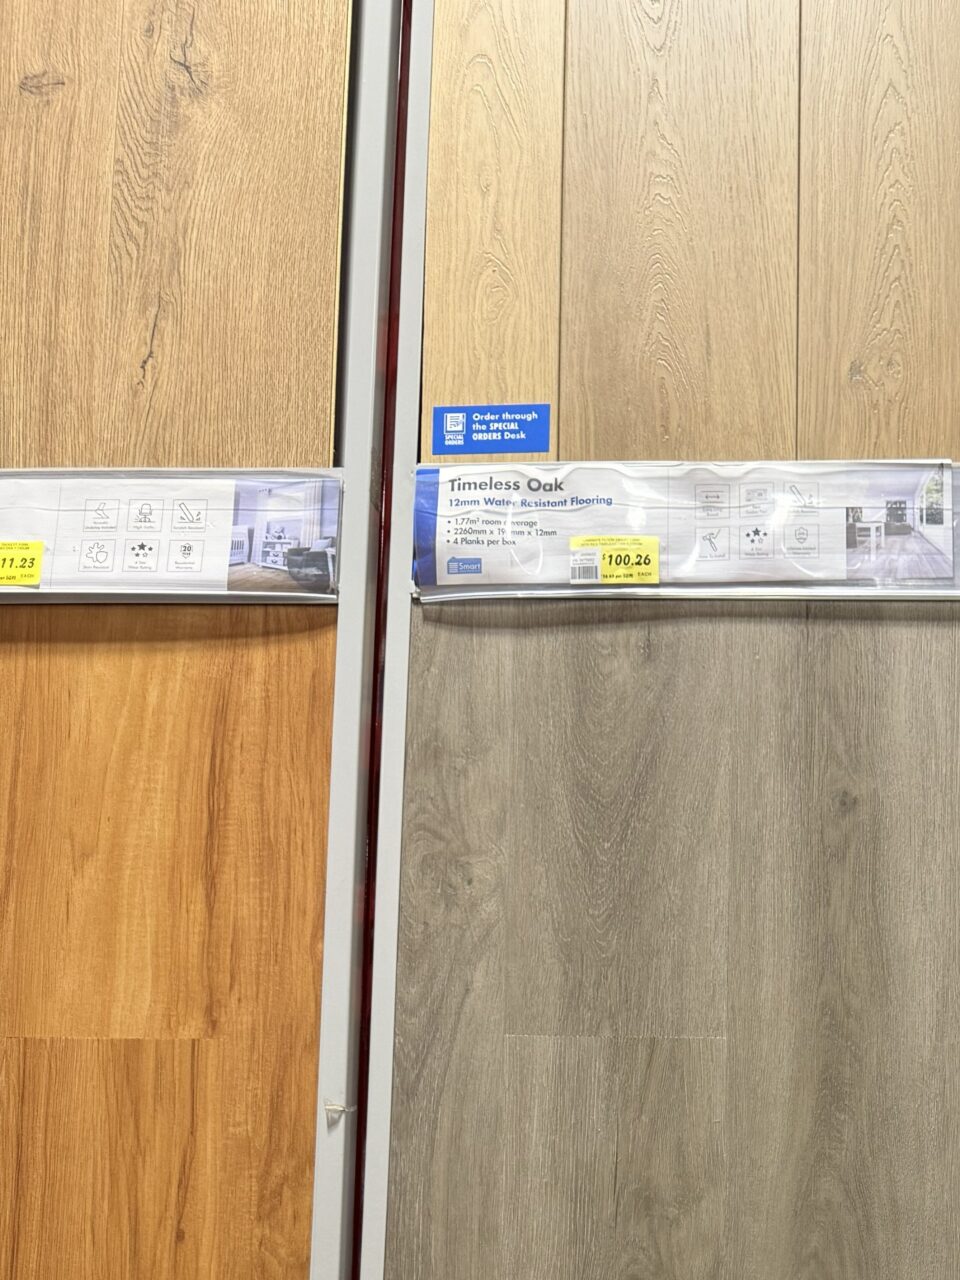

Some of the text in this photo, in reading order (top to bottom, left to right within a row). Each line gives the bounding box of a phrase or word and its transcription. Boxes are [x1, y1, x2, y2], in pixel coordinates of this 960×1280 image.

[472, 412, 538, 421] Order through
[490, 422, 518, 430] SPECIAL
[472, 432, 502, 440] ORDERS
[449, 477, 564, 492] Timeless Oak
[449, 498, 480, 507] 12mm
[520, 498, 567, 508] Resistant
[570, 496, 613, 506] Flooring
[602, 553, 651, 566] $100.26
